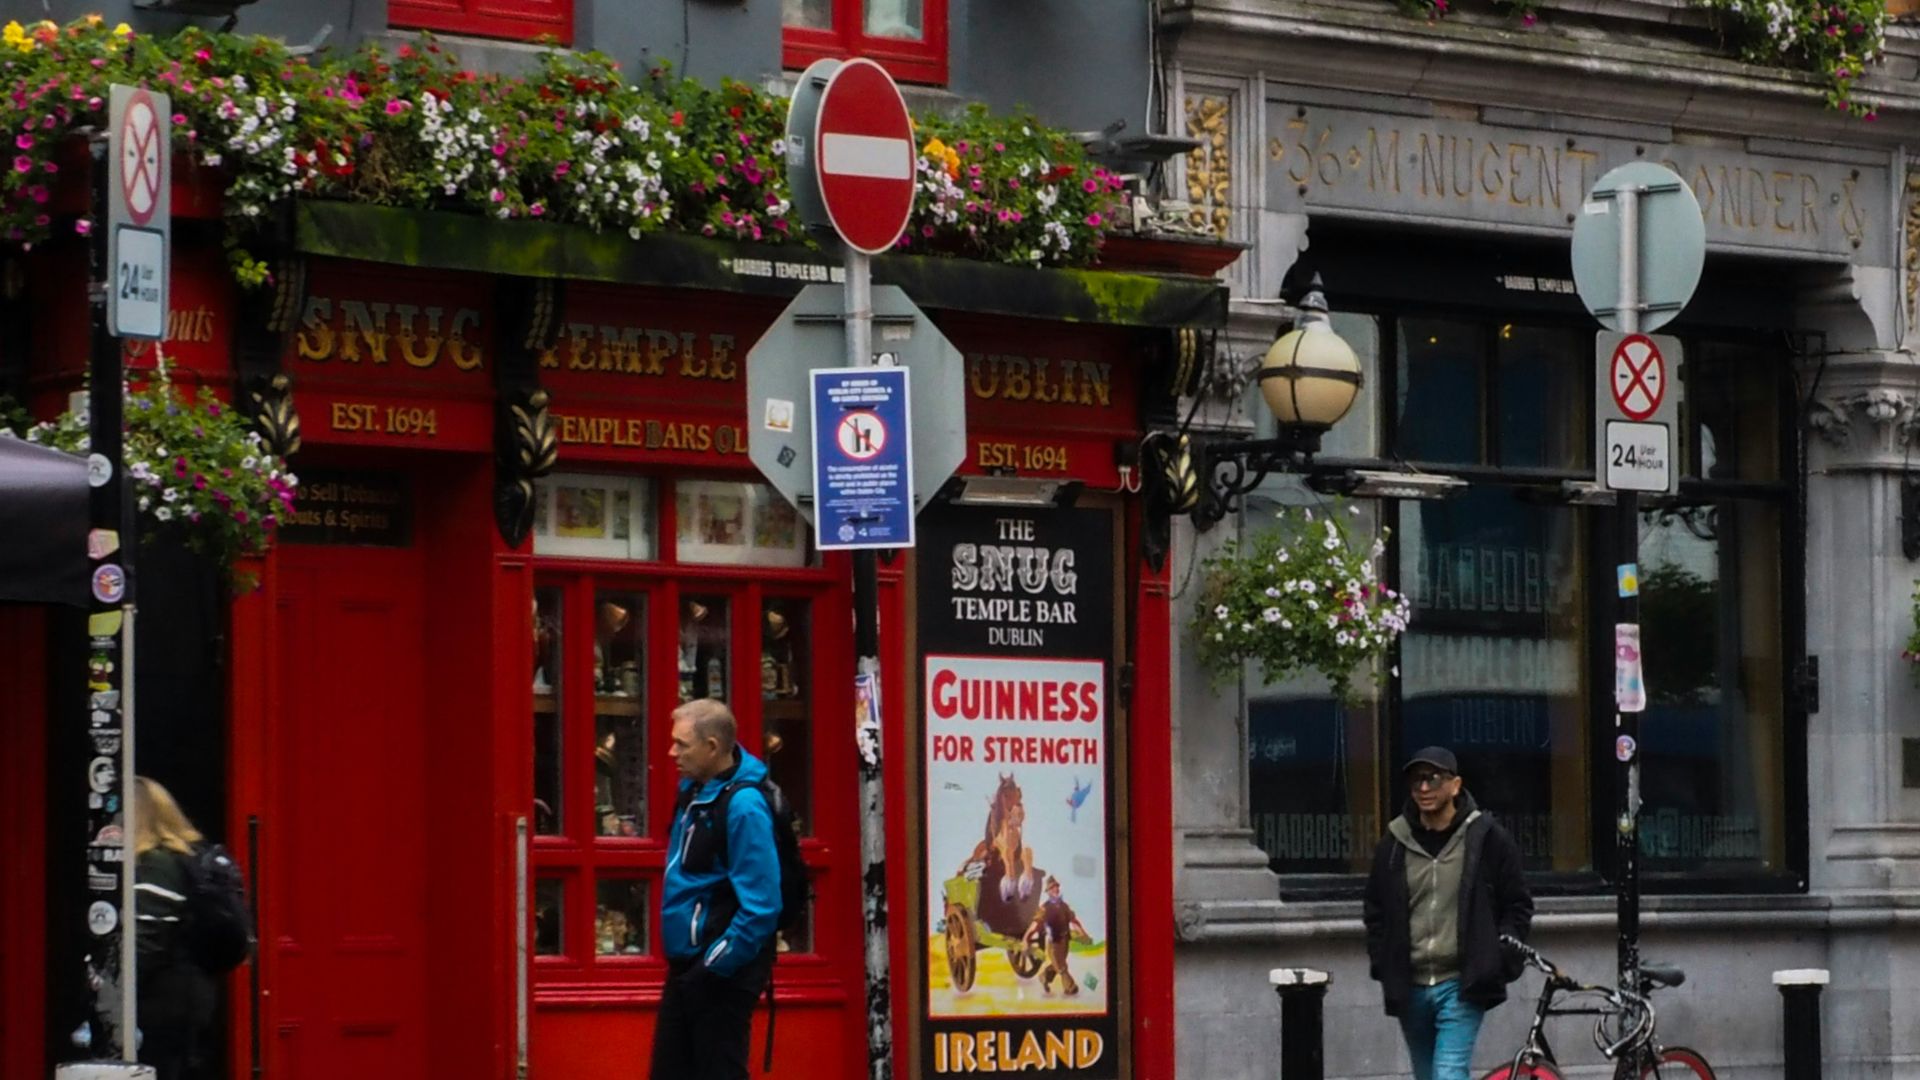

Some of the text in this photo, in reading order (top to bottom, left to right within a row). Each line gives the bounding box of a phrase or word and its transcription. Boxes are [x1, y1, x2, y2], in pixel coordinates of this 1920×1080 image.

[1419, 133, 1597, 210] NUGENT
[1661, 158, 1820, 236] ONDER
[121, 262, 139, 299] 24
[297, 296, 483, 371] SNUG
[966, 353, 1112, 406] UBLIN
[332, 403, 437, 434] EST. 1694
[714, 425, 748, 454] OL
[978, 442, 1067, 470] EST. 1694
[1612, 443, 1637, 468] 24
[324, 509, 337, 526] &
[997, 518, 1035, 541] THE
[952, 543, 1078, 595] SNUG
[952, 596, 1077, 624] TEMPLE BAR
[988, 627, 1044, 646] DUBLIN
[932, 669, 1098, 723] GUINNESS
[933, 735, 1098, 765] FOR STRENGTH
[934, 1029, 1103, 1073] IRELAND
